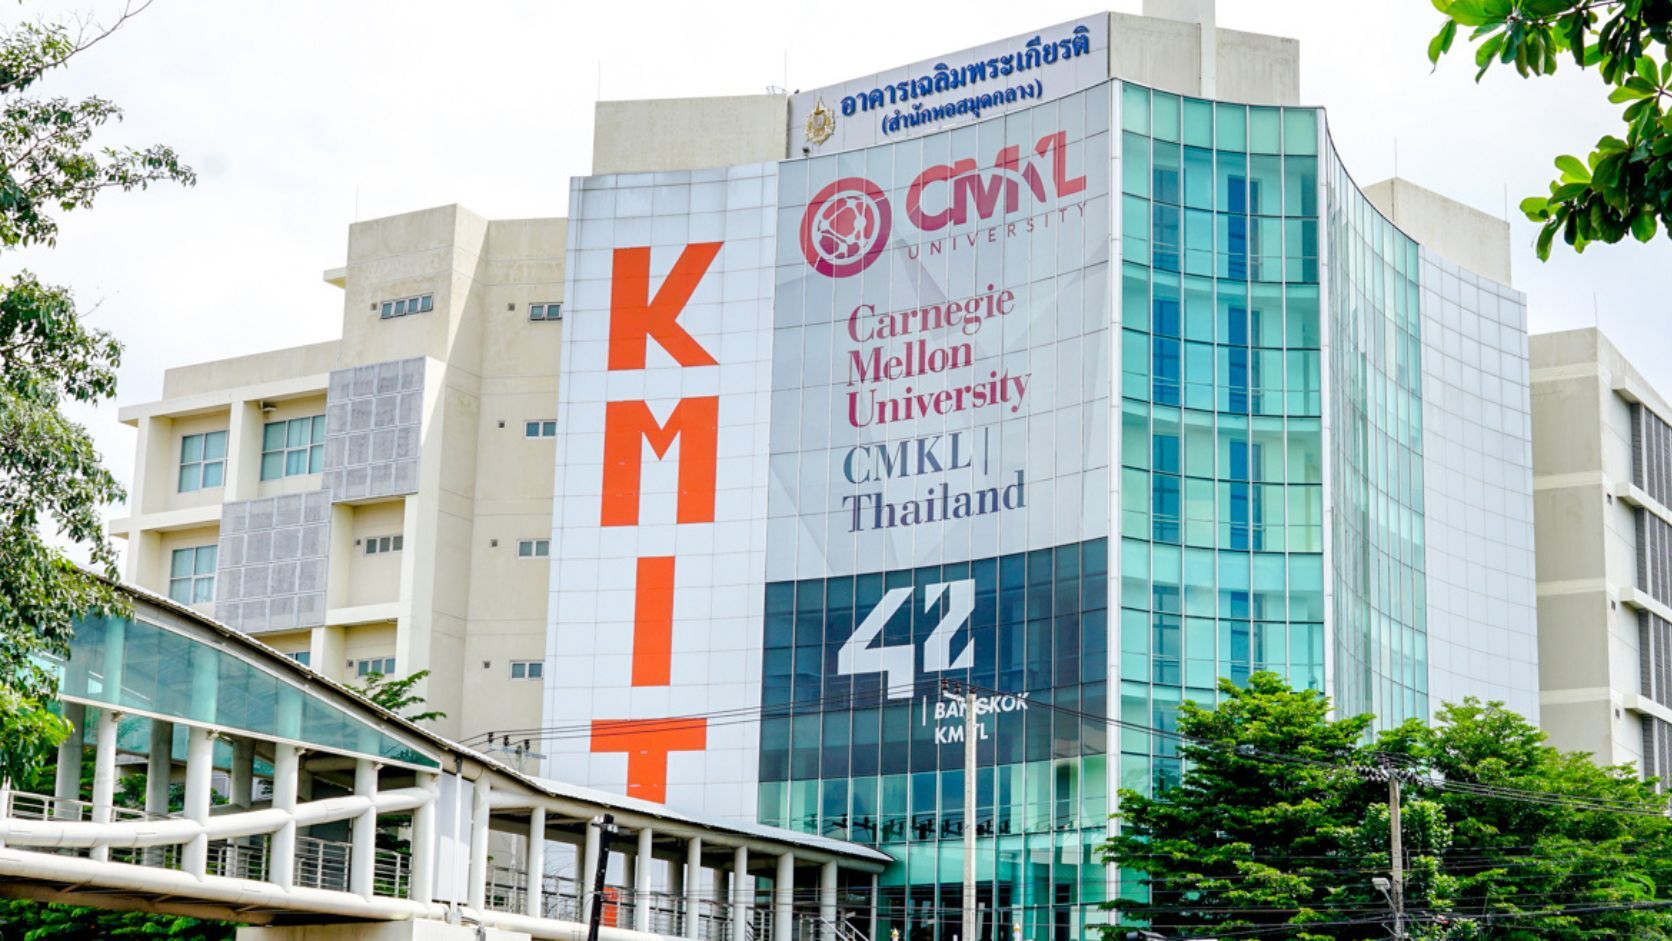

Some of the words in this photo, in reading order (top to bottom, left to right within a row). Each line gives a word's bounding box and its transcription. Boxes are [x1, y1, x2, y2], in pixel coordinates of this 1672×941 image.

[840, 25, 1091, 117] อาคารเฉลิมพระเกียรติ
[881, 78, 1043, 135] (สำนักหอสมุดกลาง)
[906, 130, 1087, 231] CMKL
[908, 202, 1087, 260] UNIVERSITY
[848, 284, 1015, 343] Carnegie
[847, 339, 973, 387] Mellon
[846, 368, 1032, 428] University
[843, 432, 972, 485] CMKL
[842, 469, 1027, 533] Thailand
[838, 578, 976, 700] 42
[934, 722, 988, 745] KML
